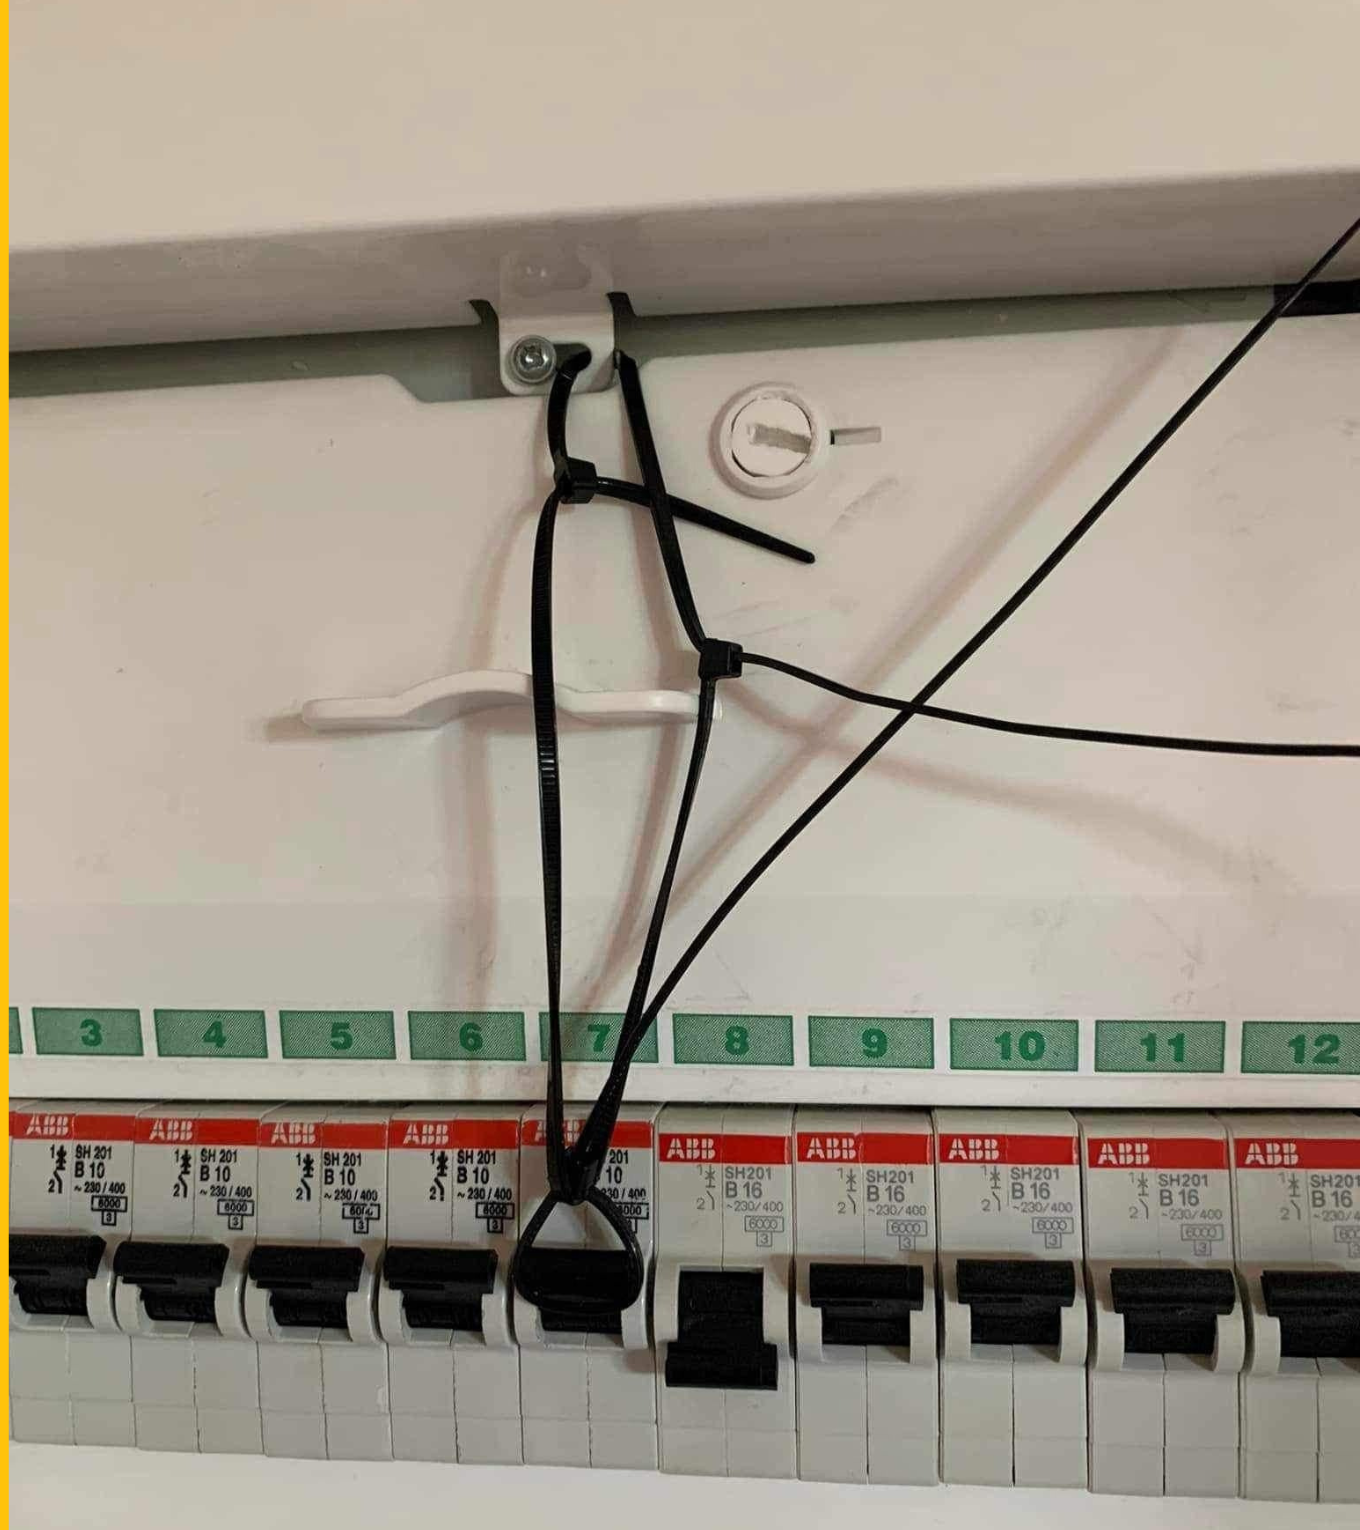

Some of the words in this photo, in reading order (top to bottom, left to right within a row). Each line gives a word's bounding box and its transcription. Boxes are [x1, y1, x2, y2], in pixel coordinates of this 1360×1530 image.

[80, 1019, 103, 1047] 3
[202, 1021, 227, 1048] 4
[330, 1022, 352, 1050] 5
[459, 1022, 483, 1051] 6
[587, 1024, 611, 1052] 7
[725, 1025, 750, 1055] 8
[861, 1028, 888, 1058] 9
[994, 1030, 1046, 1062] 10
[1140, 1031, 1186, 1063] 11
[1287, 1033, 1341, 1064] 12
[25, 1115, 69, 1136] ABB
[149, 1119, 193, 1141] ABB
[534, 1121, 581, 1142] AB
[271, 1123, 316, 1144] ABB
[403, 1123, 449, 1145] ABB
[50, 1143, 55, 1159] 1
[75, 1143, 91, 1159] SH
[94, 1145, 112, 1160] 201
[174, 1148, 179, 1163] 1
[200, 1148, 216, 1163] SH
[219, 1149, 238, 1163] 201
[666, 1138, 716, 1160] ABB
[806, 1137, 857, 1159] ABB
[948, 1138, 1000, 1160] ABB
[1098, 1143, 1150, 1165] ABB
[1244, 1143, 1299, 1165] ABB
[296, 1152, 301, 1166] 1
[323, 1151, 339, 1167] SH
[343, 1152, 362, 1167] 201
[430, 1150, 435, 1164] 1
[456, 1149, 473, 1164] SH
[477, 1150, 496, 1165] 201
[609, 1150, 629, 1164] 201
[74, 1161, 85, 1178] B
[89, 1162, 105, 1179] 10
[200, 1165, 210, 1182] B
[215, 1165, 231, 1182] 10
[324, 1168, 334, 1185] B
[340, 1168, 356, 1186] 10
[456, 1166, 468, 1183] B
[472, 1167, 490, 1184] 10
[606, 1167, 622, 1184] 10
[697, 1164, 703, 1176] 1
[837, 1167, 843, 1180] 1
[980, 1165, 987, 1176] 1
[1128, 1171, 1134, 1184] 1
[48, 1178, 55, 1193] 2
[1278, 1172, 1285, 1184] 1
[172, 1183, 180, 1197] 2
[296, 1188, 303, 1201] 2
[429, 1186, 436, 1201] 2
[725, 1181, 737, 1198] B
[743, 1181, 763, 1199] 16
[866, 1185, 879, 1202] B
[885, 1185, 905, 1203] 16
[1011, 1182, 1025, 1200] B
[1030, 1182, 1051, 1200] 16
[1159, 1189, 1173, 1207] B
[1178, 1188, 1200, 1207] 16
[98, 1198, 121, 1209] 6000
[696, 1197, 705, 1210] 2
[981, 1199, 991, 1212] 2
[1312, 1190, 1326, 1208] B
[1331, 1190, 1353, 1208] 16
[224, 1202, 248, 1212] 6000
[483, 1204, 508, 1216] 6000
[837, 1202, 846, 1214] 2
[1128, 1206, 1138, 1219] 2
[1280, 1207, 1290, 1220] 2
[106, 1212, 112, 1222] 3
[233, 1217, 239, 1226] 3
[748, 1217, 778, 1230] 6000
[358, 1220, 364, 1230] 3
[492, 1220, 499, 1230] 3
[891, 1221, 921, 1234] 6000
[1036, 1220, 1067, 1232] 6000
[760, 1233, 769, 1245] 3
[1049, 1234, 1058, 1246] 3
[1185, 1227, 1217, 1239] 6000
[903, 1237, 912, 1249] 3
[1198, 1242, 1207, 1253] 3
